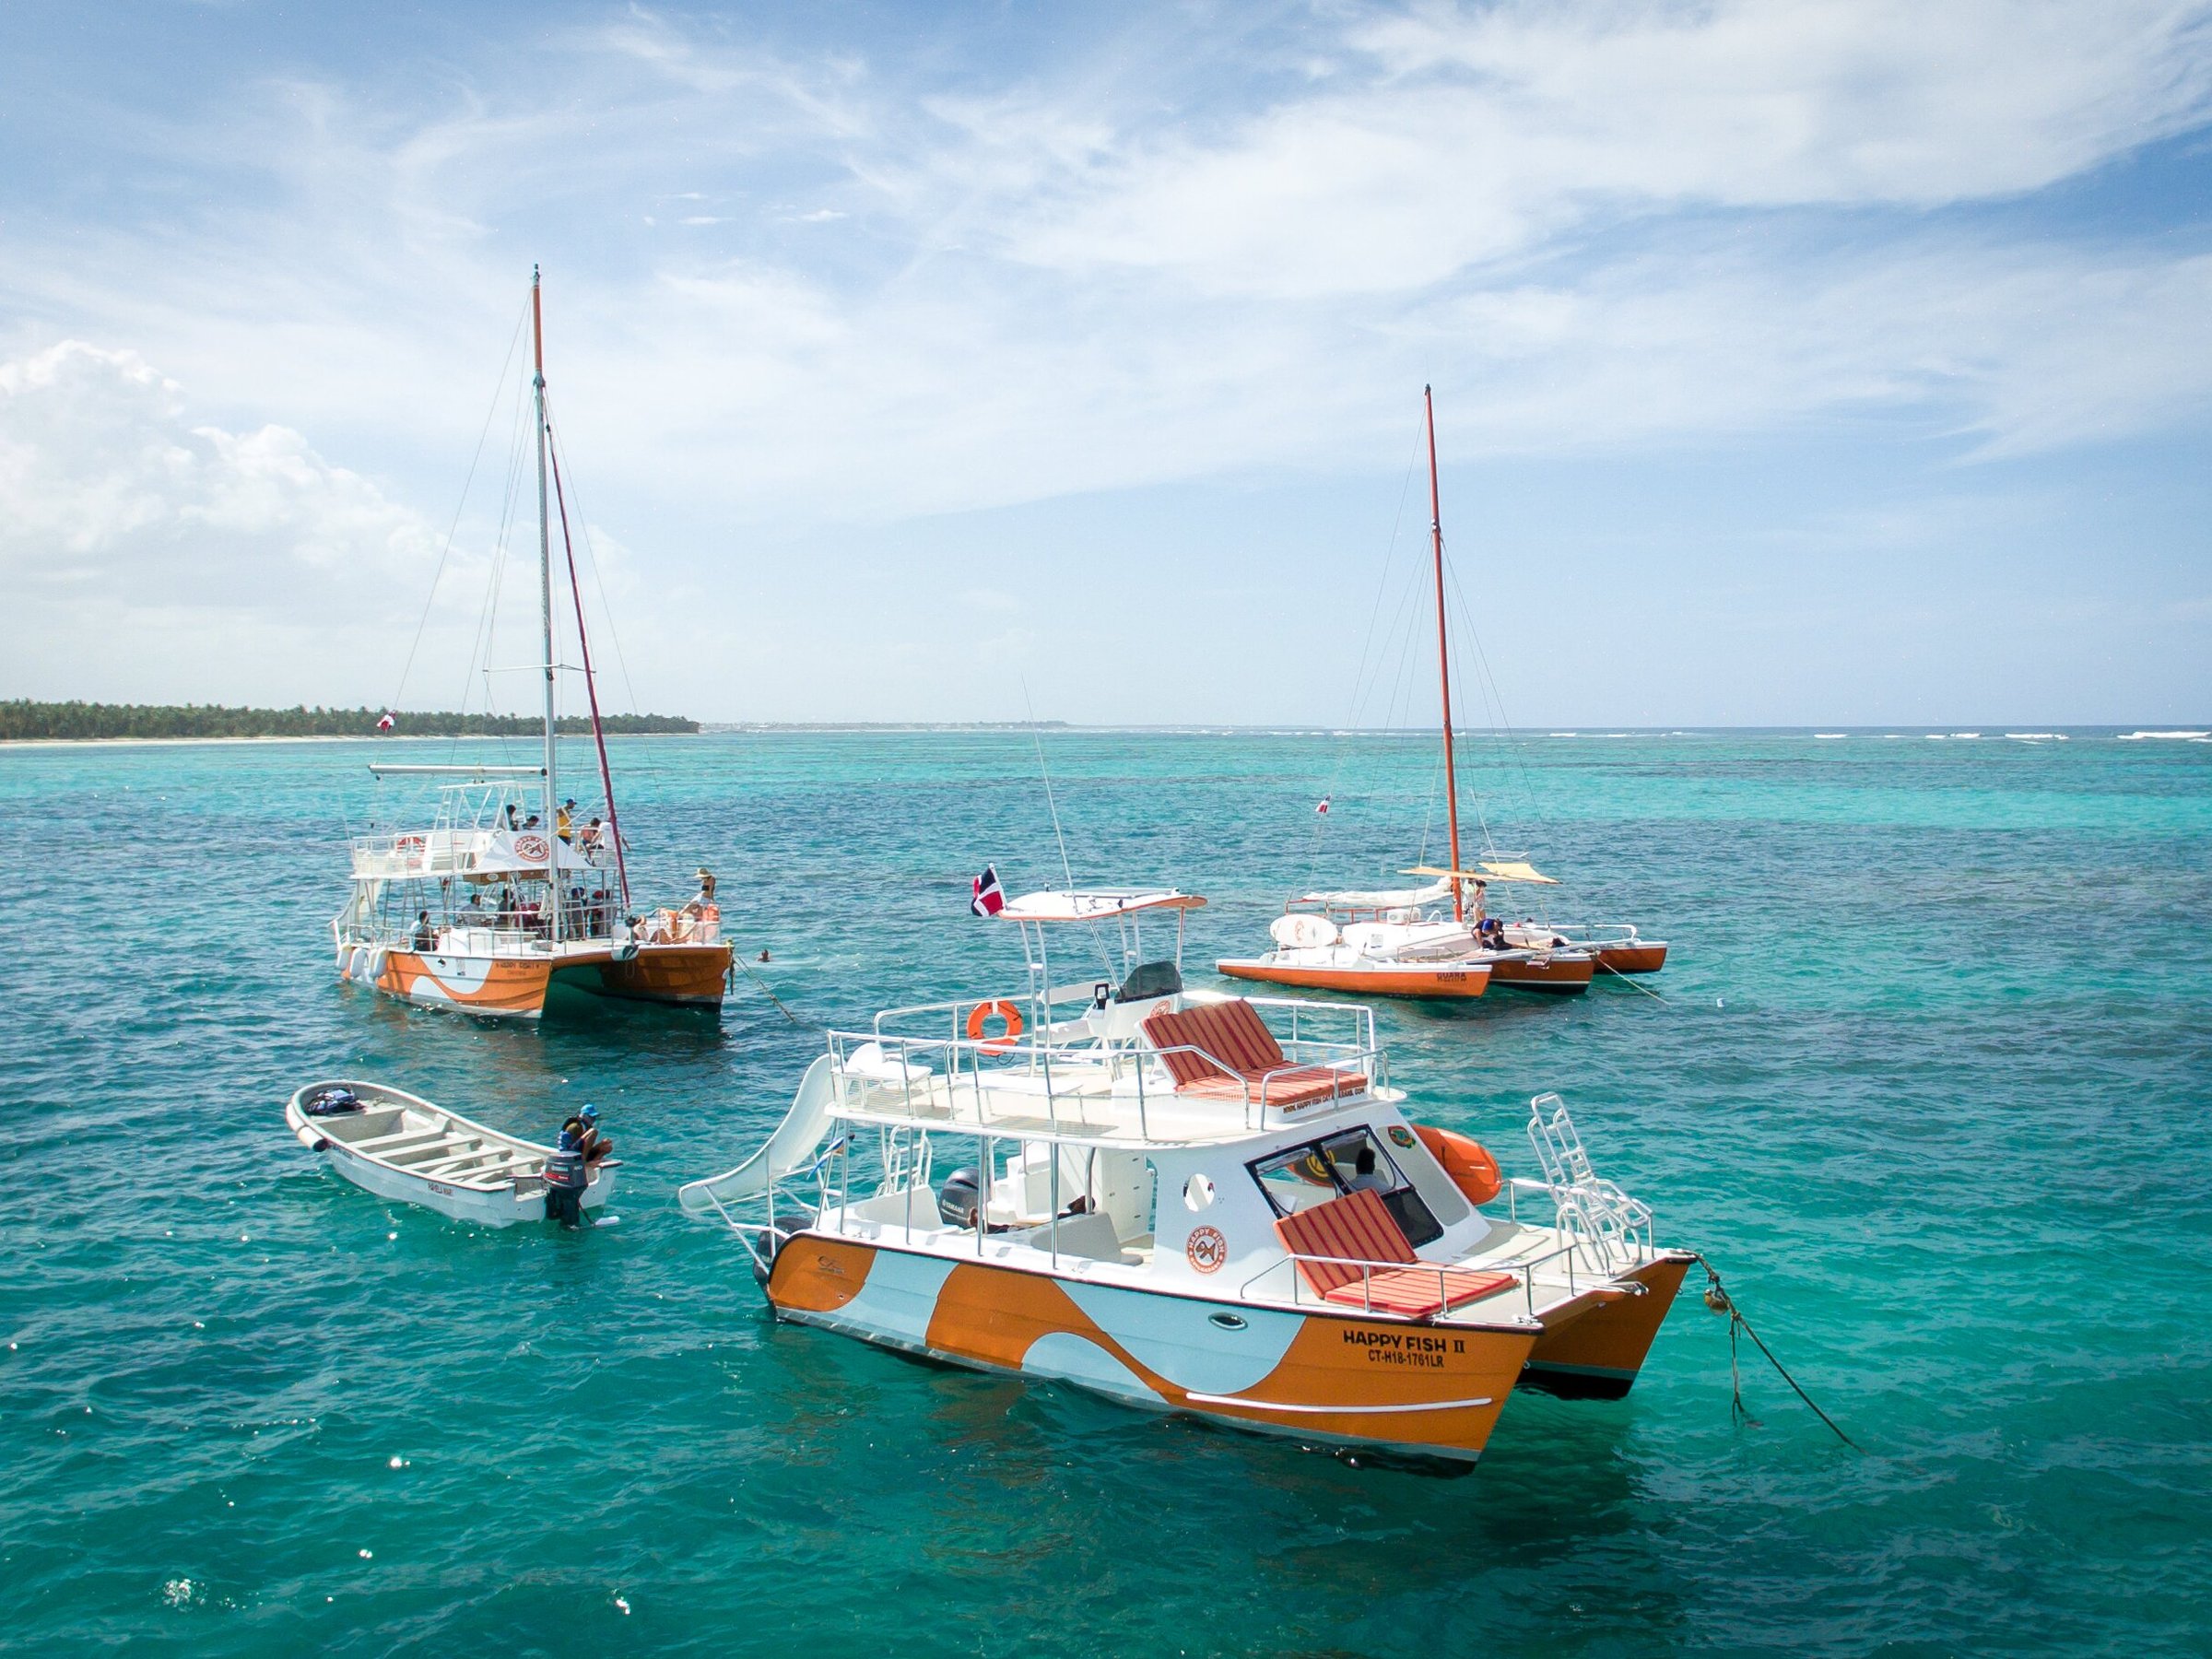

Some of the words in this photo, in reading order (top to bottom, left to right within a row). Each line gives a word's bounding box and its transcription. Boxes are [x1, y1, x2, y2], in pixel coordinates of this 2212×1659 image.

[1189, 1228, 1209, 1249] HAPPY
[1343, 1330, 1402, 1348] HAPPY
[1406, 1336, 1446, 1352] FISH
[1453, 1339, 1465, 1354] II
[1368, 1348, 1444, 1368] CT-H18-1761LR
